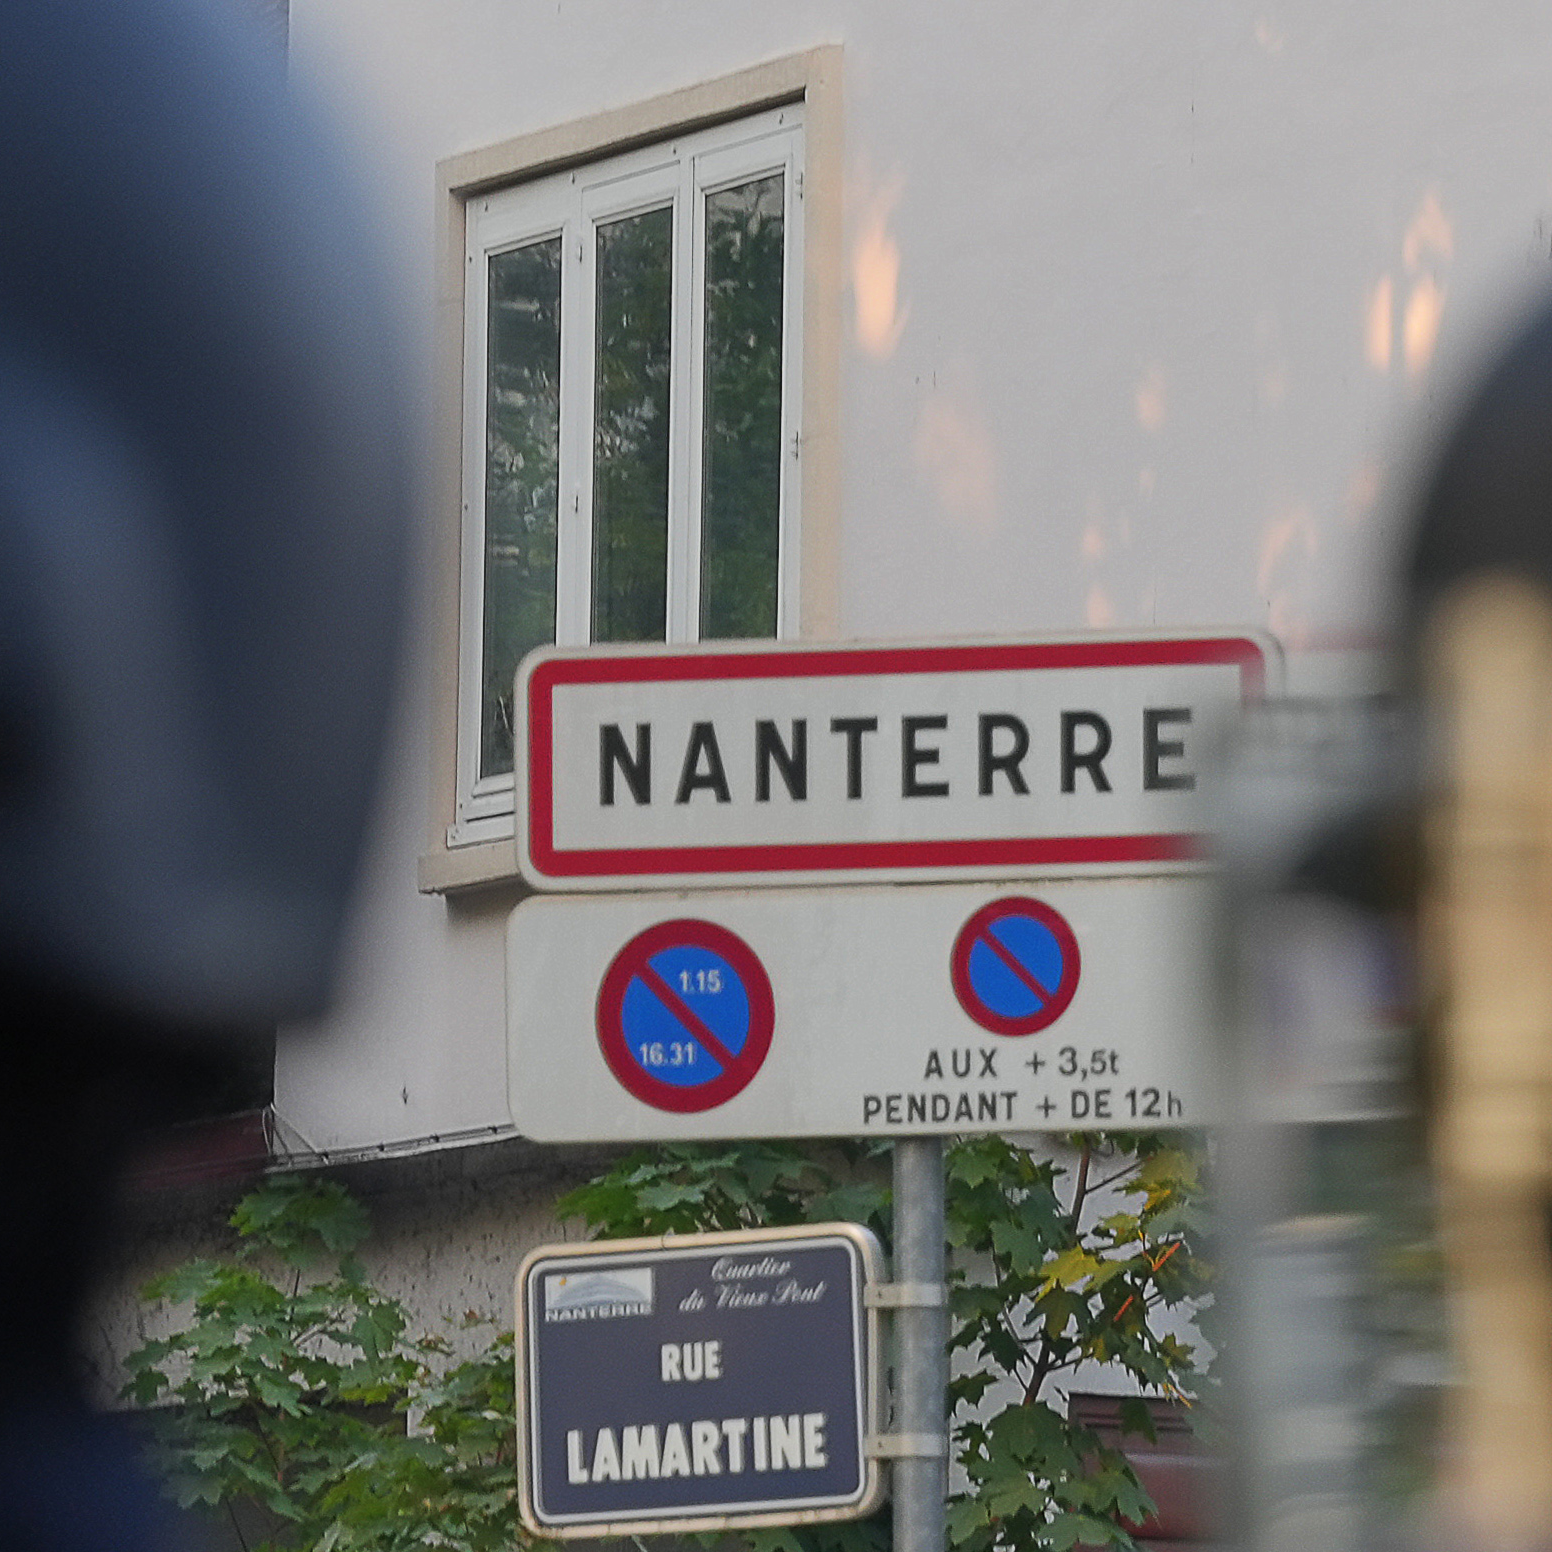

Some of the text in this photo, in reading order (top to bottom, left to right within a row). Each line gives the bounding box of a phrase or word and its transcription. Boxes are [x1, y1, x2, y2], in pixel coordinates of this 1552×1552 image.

[599, 707, 1196, 806] NANTERRE
[638, 1041, 696, 1067] 16.31
[924, 1047, 1120, 1081] AUX + 3,5t
[862, 1088, 1183, 1125] PENDANT + DE 12h
[711, 1257, 792, 1280] Quartier
[678, 1289, 704, 1312] du
[661, 1340, 721, 1382] RUE
[567, 1412, 827, 1485] LAMARTINE
